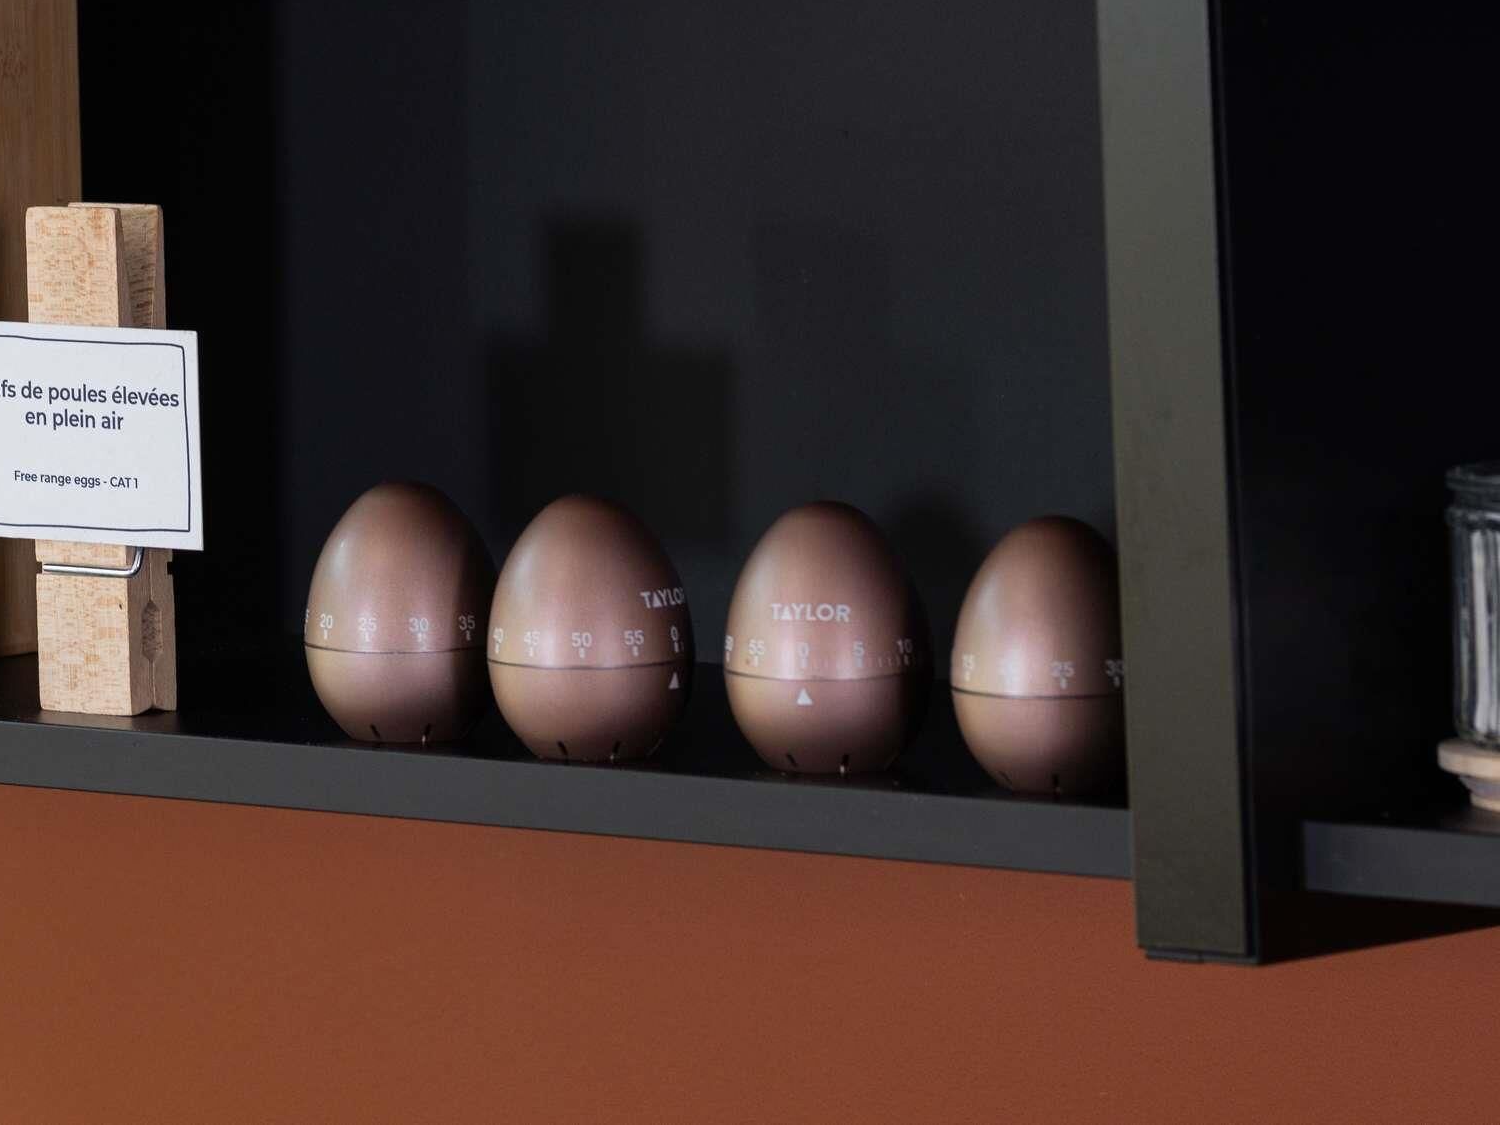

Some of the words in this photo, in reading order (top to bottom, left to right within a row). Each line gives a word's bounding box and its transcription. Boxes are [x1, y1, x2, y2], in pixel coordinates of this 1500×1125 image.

[21, 381, 43, 400] de
[49, 384, 107, 404] poules
[112, 386, 180, 407] élevées
[25, 411, 47, 426] en
[53, 409, 96, 430] plein
[101, 411, 124, 430] air
[14, 471, 38, 482] Free
[40, 475, 72, 488] range
[74, 477, 101, 489] eggs
[110, 477, 131, 488] CAT
[640, 587, 685, 609] TAYLO
[771, 603, 851, 622] TAYLOR
[319, 613, 333, 629] 20
[358, 617, 377, 632] 25
[409, 617, 429, 632] 30
[458, 615, 476, 630] 35
[523, 631, 541, 646] 45
[571, 632, 593, 648] 50
[624, 630, 645, 645] 55
[853, 641, 865, 656] 5
[897, 639, 914, 654] 10
